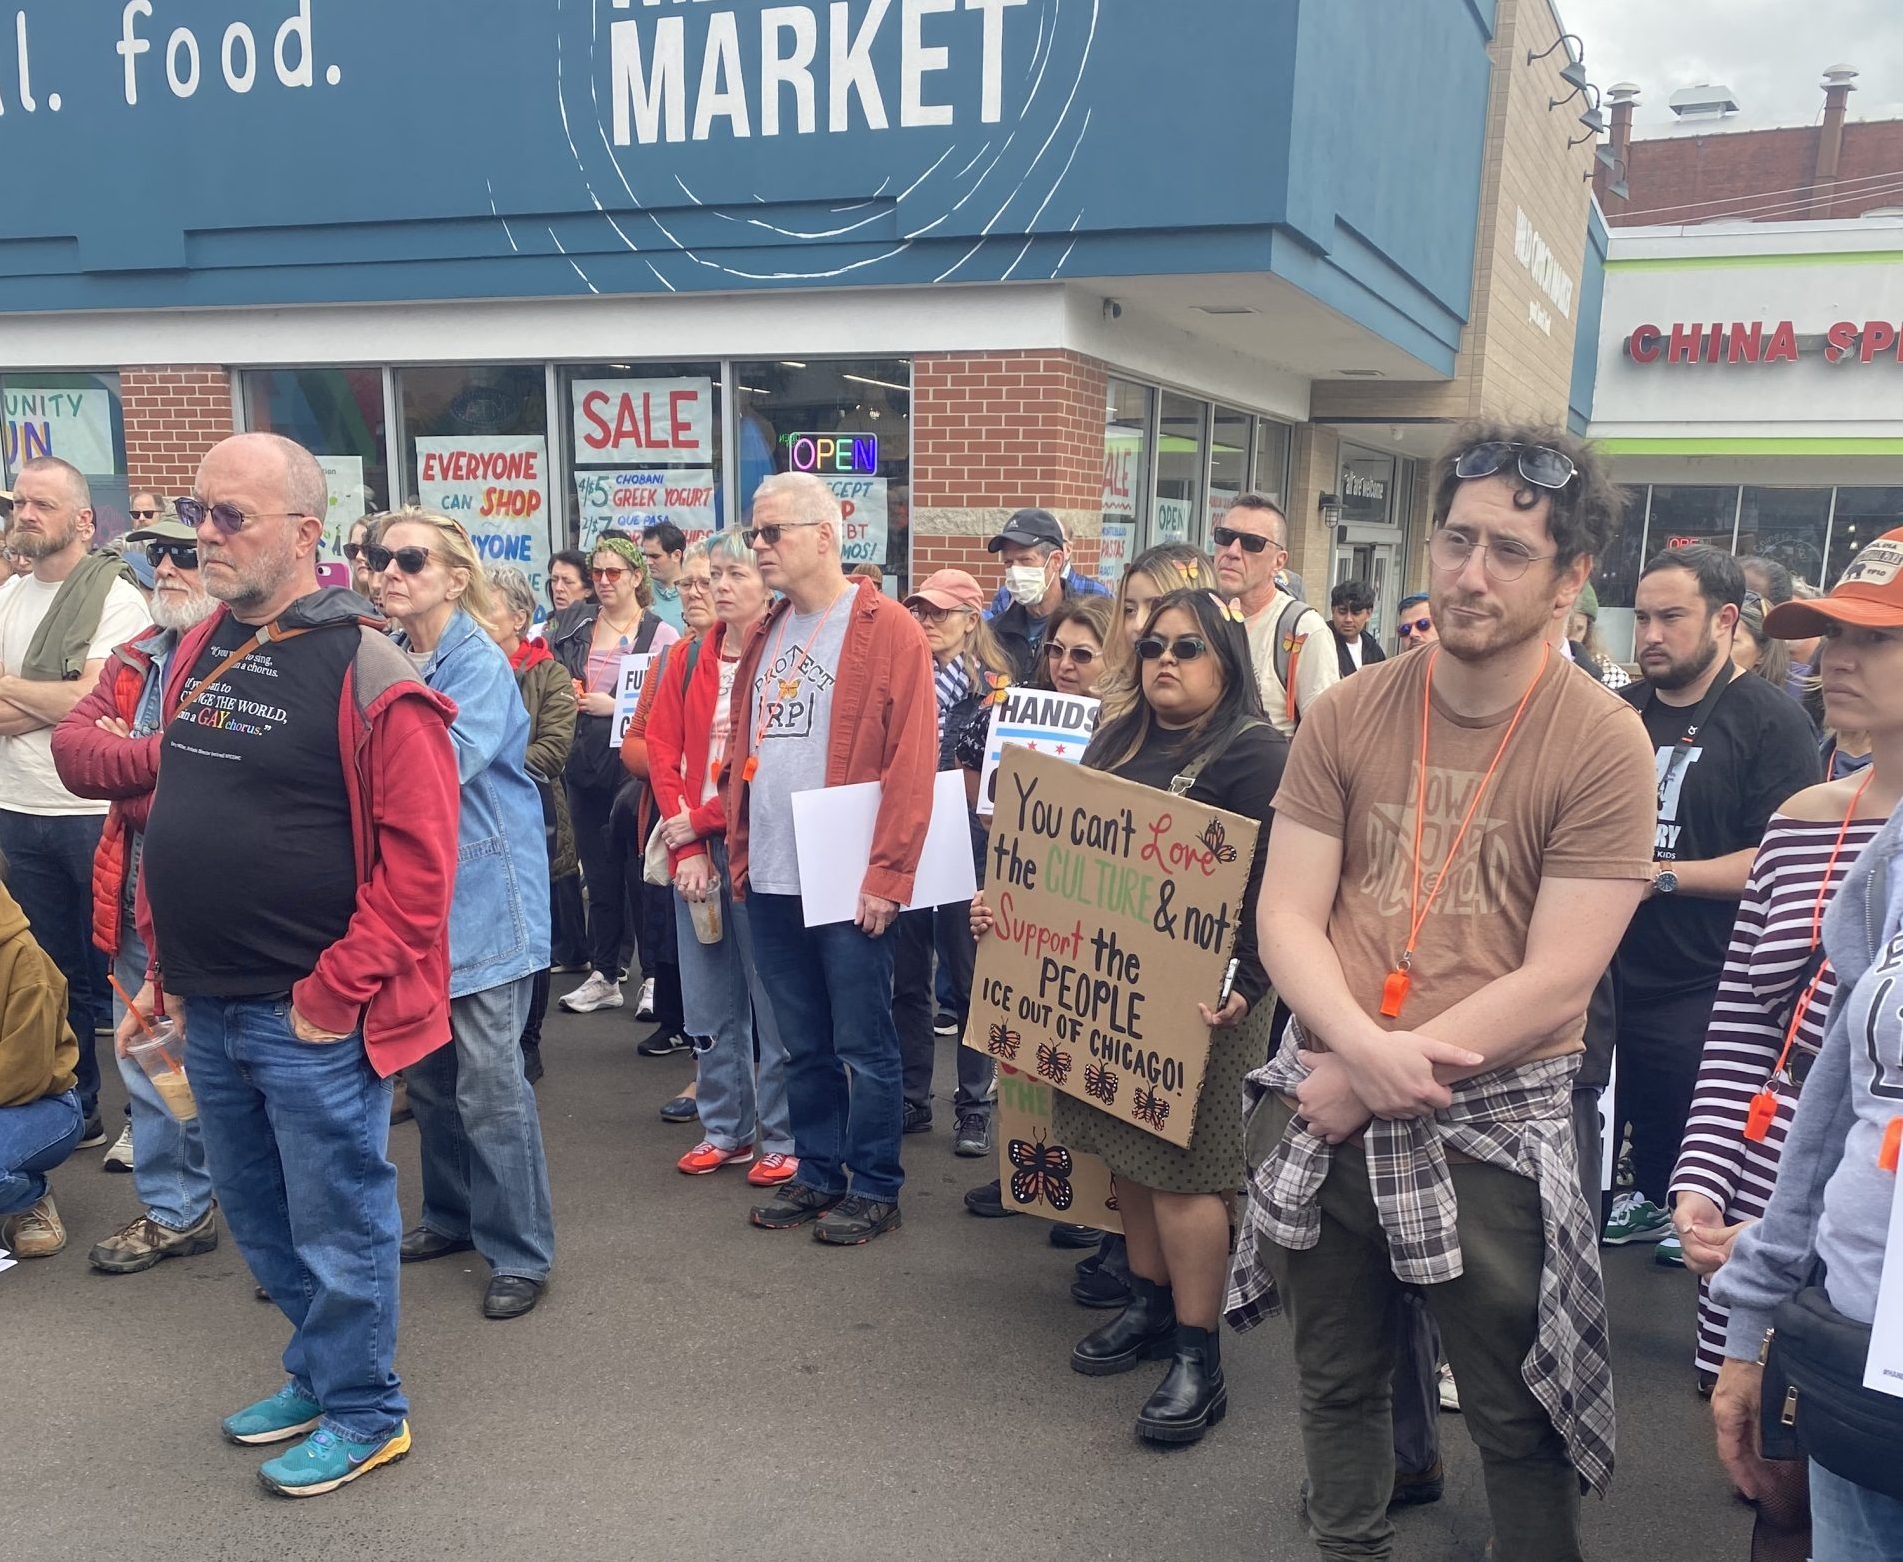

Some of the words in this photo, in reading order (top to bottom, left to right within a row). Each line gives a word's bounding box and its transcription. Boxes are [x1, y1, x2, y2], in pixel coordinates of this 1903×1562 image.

[116, 0, 342, 105] food.
[610, 0, 1028, 146] MARKET
[1629, 321, 1799, 364] CHINA
[582, 390, 700, 450] SALE
[422, 451, 538, 481] EVERYONE
[793, 437, 875, 471] OPEN
[615, 474, 664, 486] CHOBANI
[1102, 446, 1132, 498] ALE
[441, 495, 472, 510] CAN
[479, 487, 542, 517] SHOP
[612, 487, 657, 507] GREEK
[664, 487, 712, 507] YOGURT
[617, 515, 640, 527] QUE
[643, 515, 671, 527] PASA
[842, 523, 869, 539] BT
[1159, 505, 1186, 531] OPEN
[471, 534, 532, 561] YONE
[247, 662, 279, 678] chorus.
[754, 644, 835, 692] PROTECT
[220, 682, 232, 694] to
[180, 689, 216, 707] CNGE
[215, 695, 237, 711] THE
[238, 698, 288, 726] WORLD,
[197, 707, 230, 729] GAY
[766, 701, 805, 728] RP
[998, 694, 1101, 733] HANDS
[1013, 771, 1063, 839] You
[1071, 807, 1136, 858] can't
[1141, 813, 1216, 877] Love
[1654, 822, 1682, 849] RY
[1656, 851, 1677, 860] KIDS
[993, 833, 1037, 890] the
[1044, 845, 1155, 925] CULTURE
[1153, 879, 1176, 940] &
[1183, 902, 1230, 953] not
[992, 892, 1084, 960] Support
[1090, 927, 1141, 985] the
[1039, 956, 1146, 1040] PEOPLE
[982, 977, 1014, 1012] ICE
[1018, 996, 1053, 1028] OUT
[1056, 1013, 1084, 1043] OF
[1089, 1028, 1185, 1097] CHICAGO!
